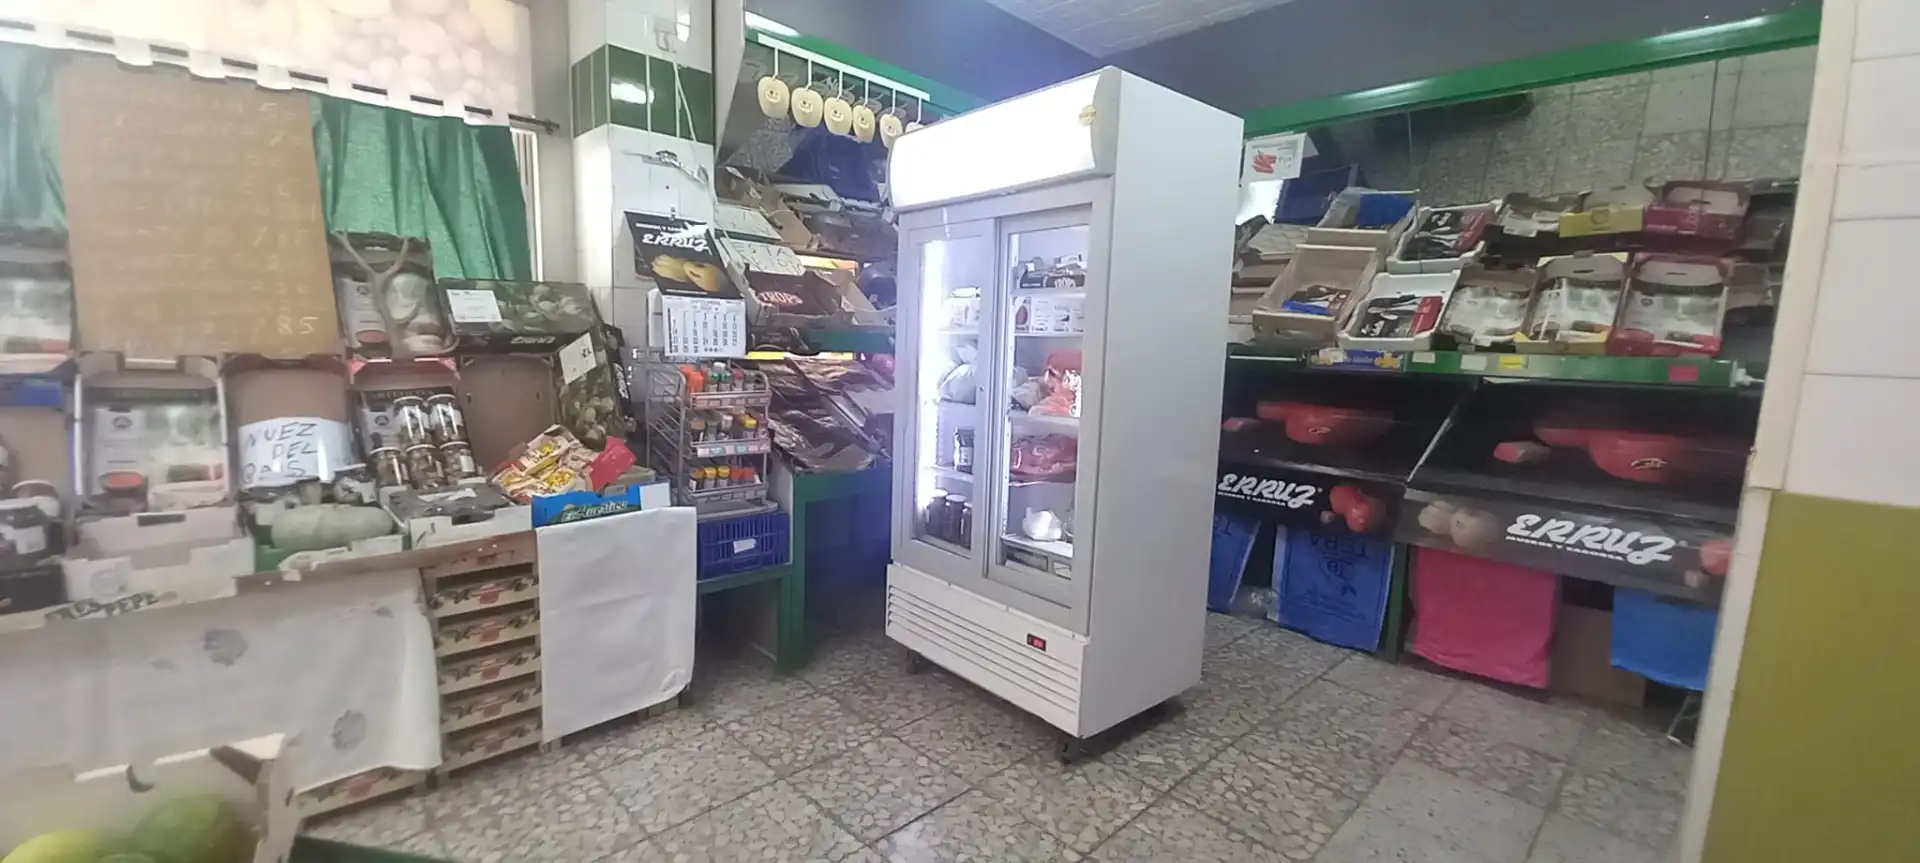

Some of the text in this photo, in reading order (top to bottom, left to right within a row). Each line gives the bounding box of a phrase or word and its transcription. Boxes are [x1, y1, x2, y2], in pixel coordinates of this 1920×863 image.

[246, 421, 318, 448] NUEZ
[272, 440, 319, 460] DEL
[1217, 473, 1316, 508] ERRUZ
[1506, 514, 1677, 565] ERRUZ
